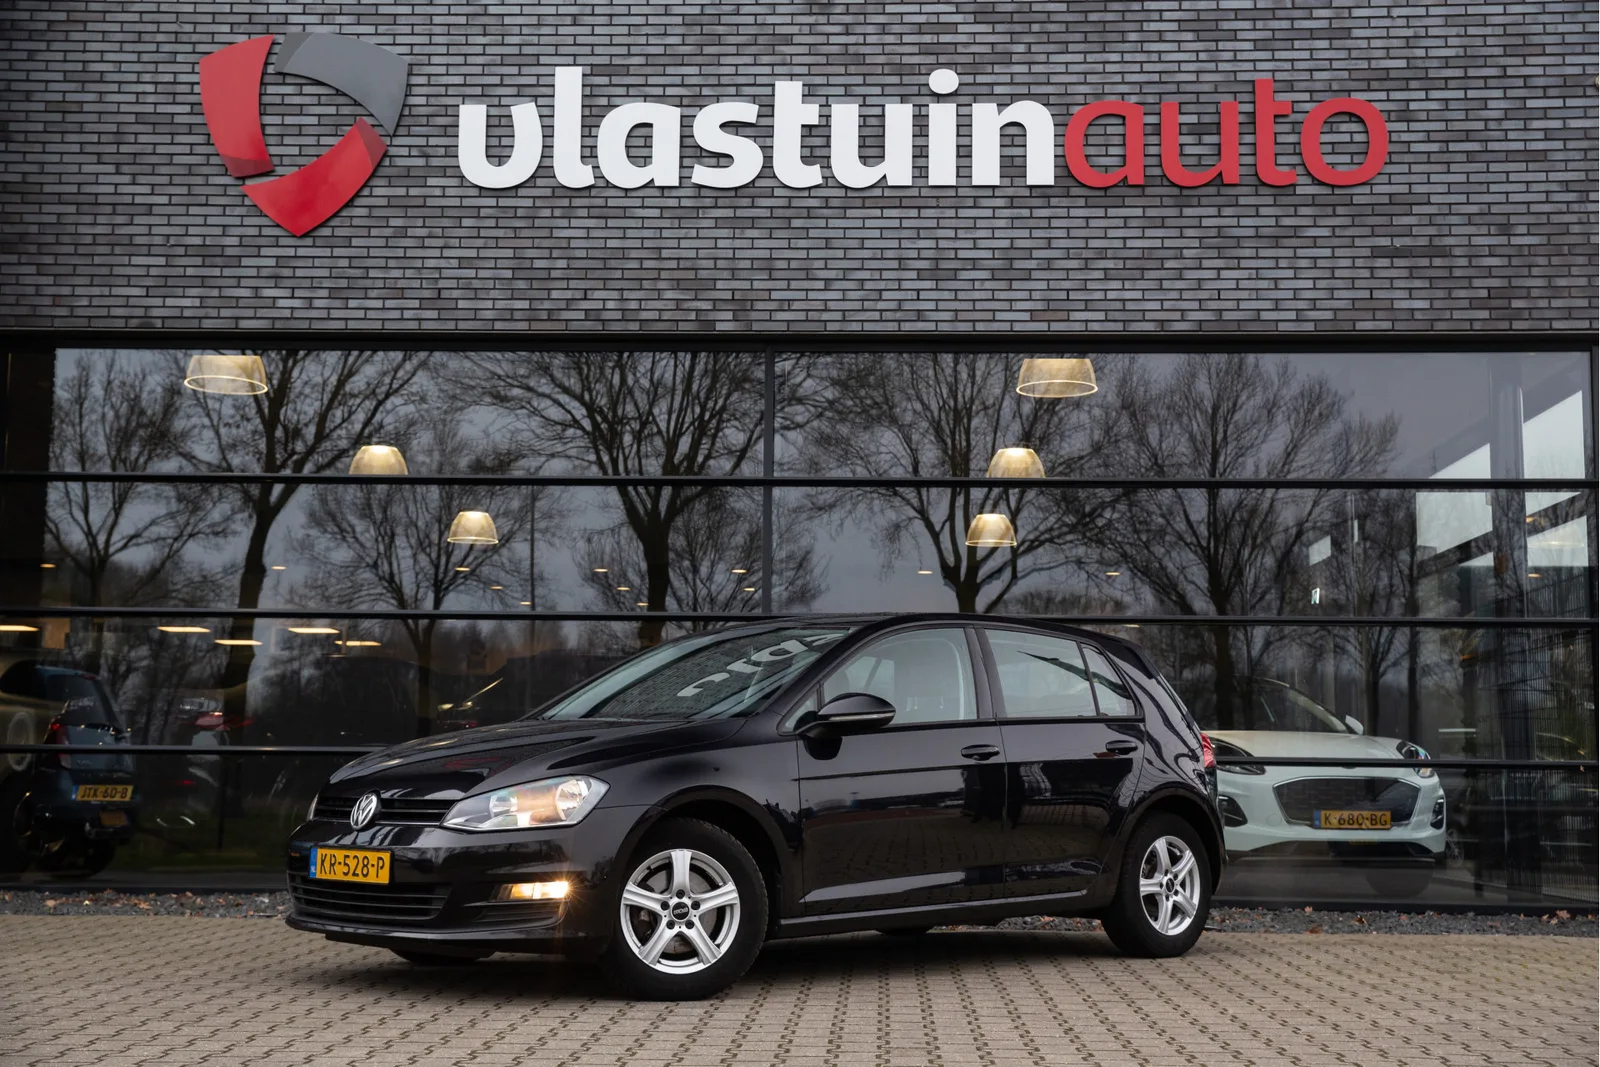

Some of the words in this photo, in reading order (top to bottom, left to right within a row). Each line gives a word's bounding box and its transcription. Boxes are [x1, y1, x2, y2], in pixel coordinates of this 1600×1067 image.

[80, 786, 128, 799] JTK-60-B
[1324, 812, 1388, 826] K-680-BG
[319, 853, 385, 878] KR-528-P
